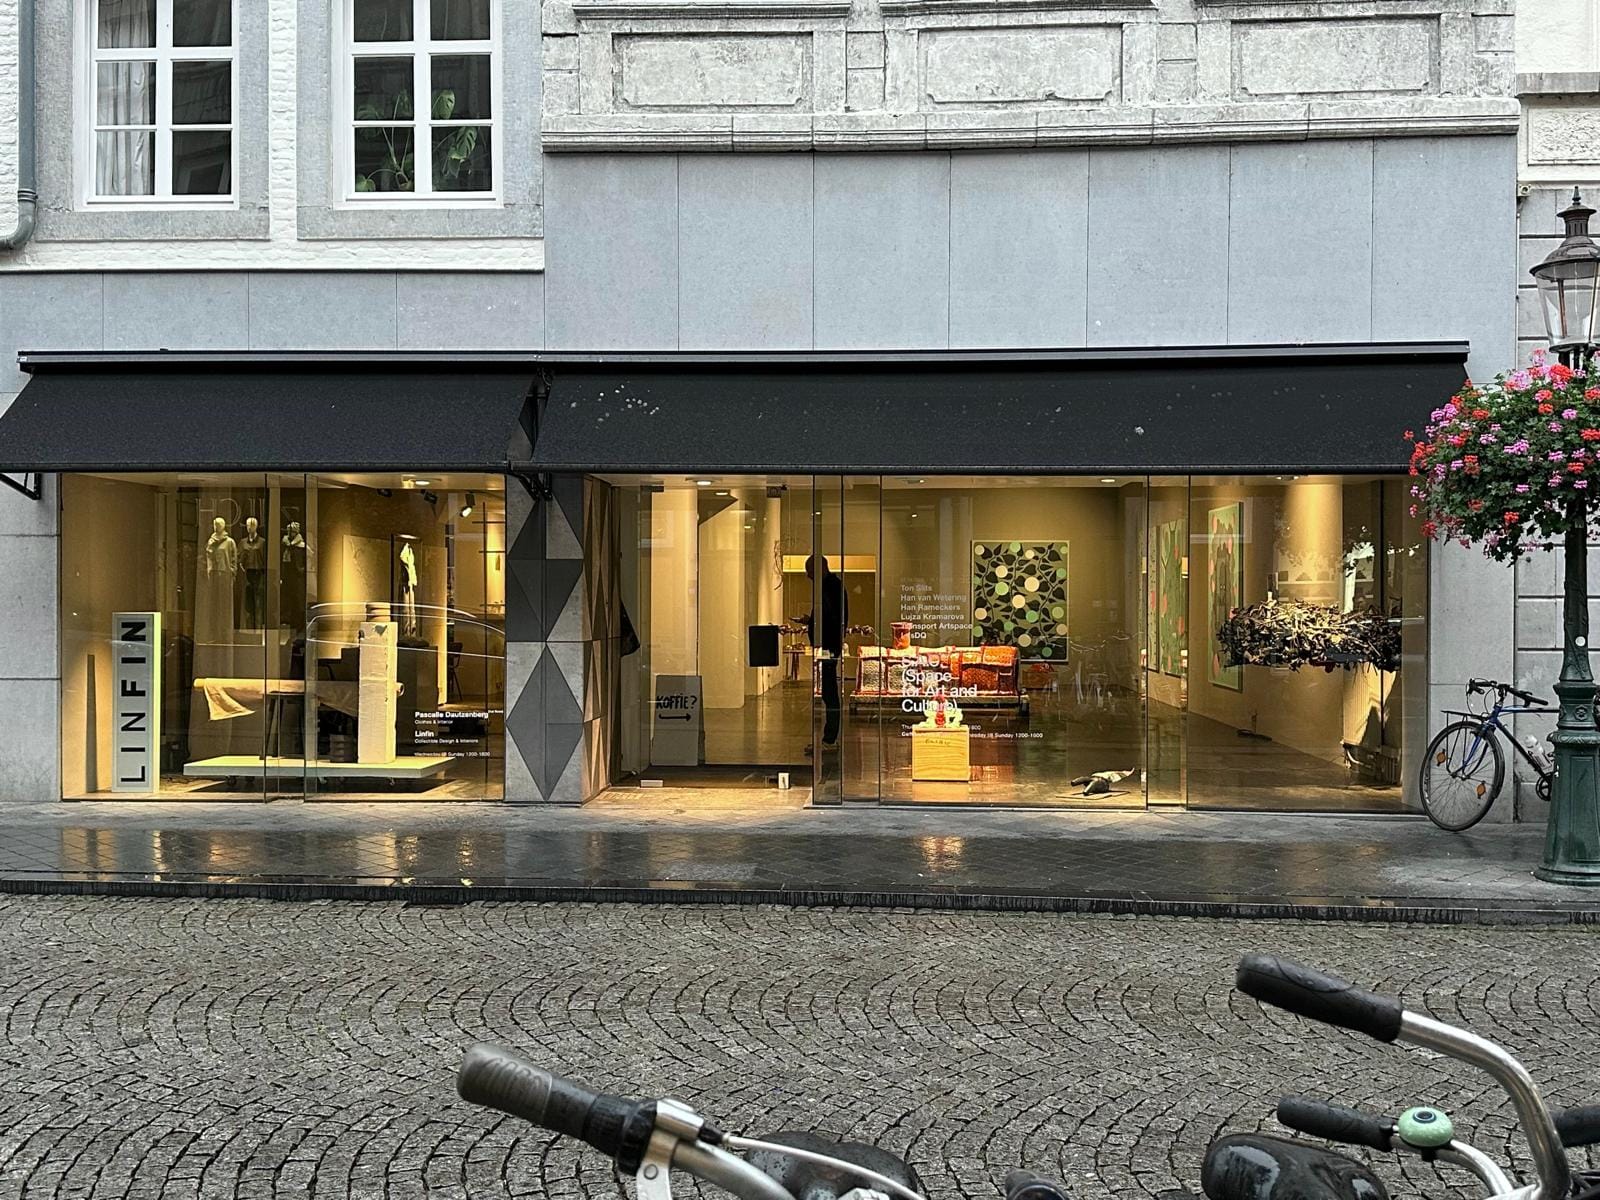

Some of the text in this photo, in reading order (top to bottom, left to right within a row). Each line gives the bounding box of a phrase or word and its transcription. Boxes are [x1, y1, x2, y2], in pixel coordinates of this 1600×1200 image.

[950, 684, 977, 697] and
[121, 622, 146, 782] LINFIN
[656, 693, 698, 709] KOFFIE?
